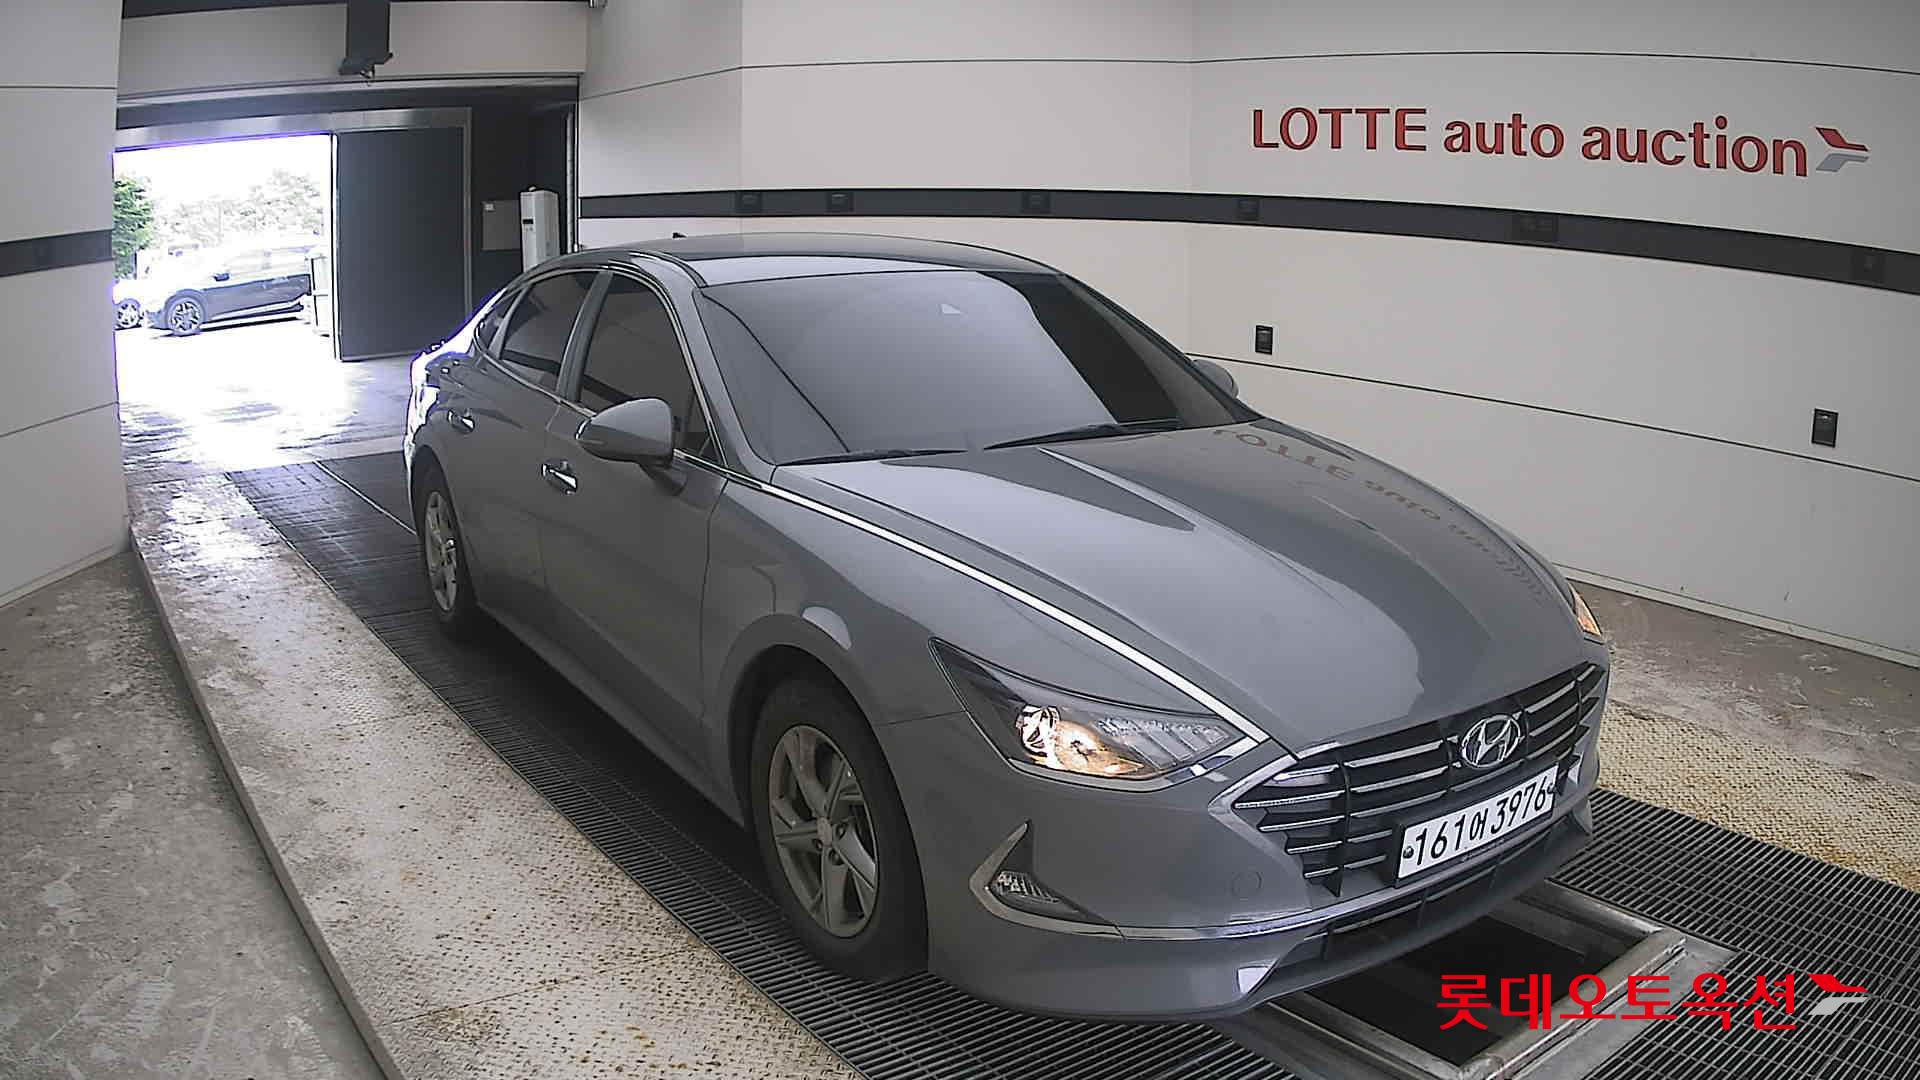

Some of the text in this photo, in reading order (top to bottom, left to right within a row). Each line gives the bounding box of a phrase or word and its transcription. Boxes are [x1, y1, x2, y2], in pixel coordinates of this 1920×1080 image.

[1253, 107, 1808, 177] LOTTE auto auction
[1416, 776, 1547, 866] 161어 3976
